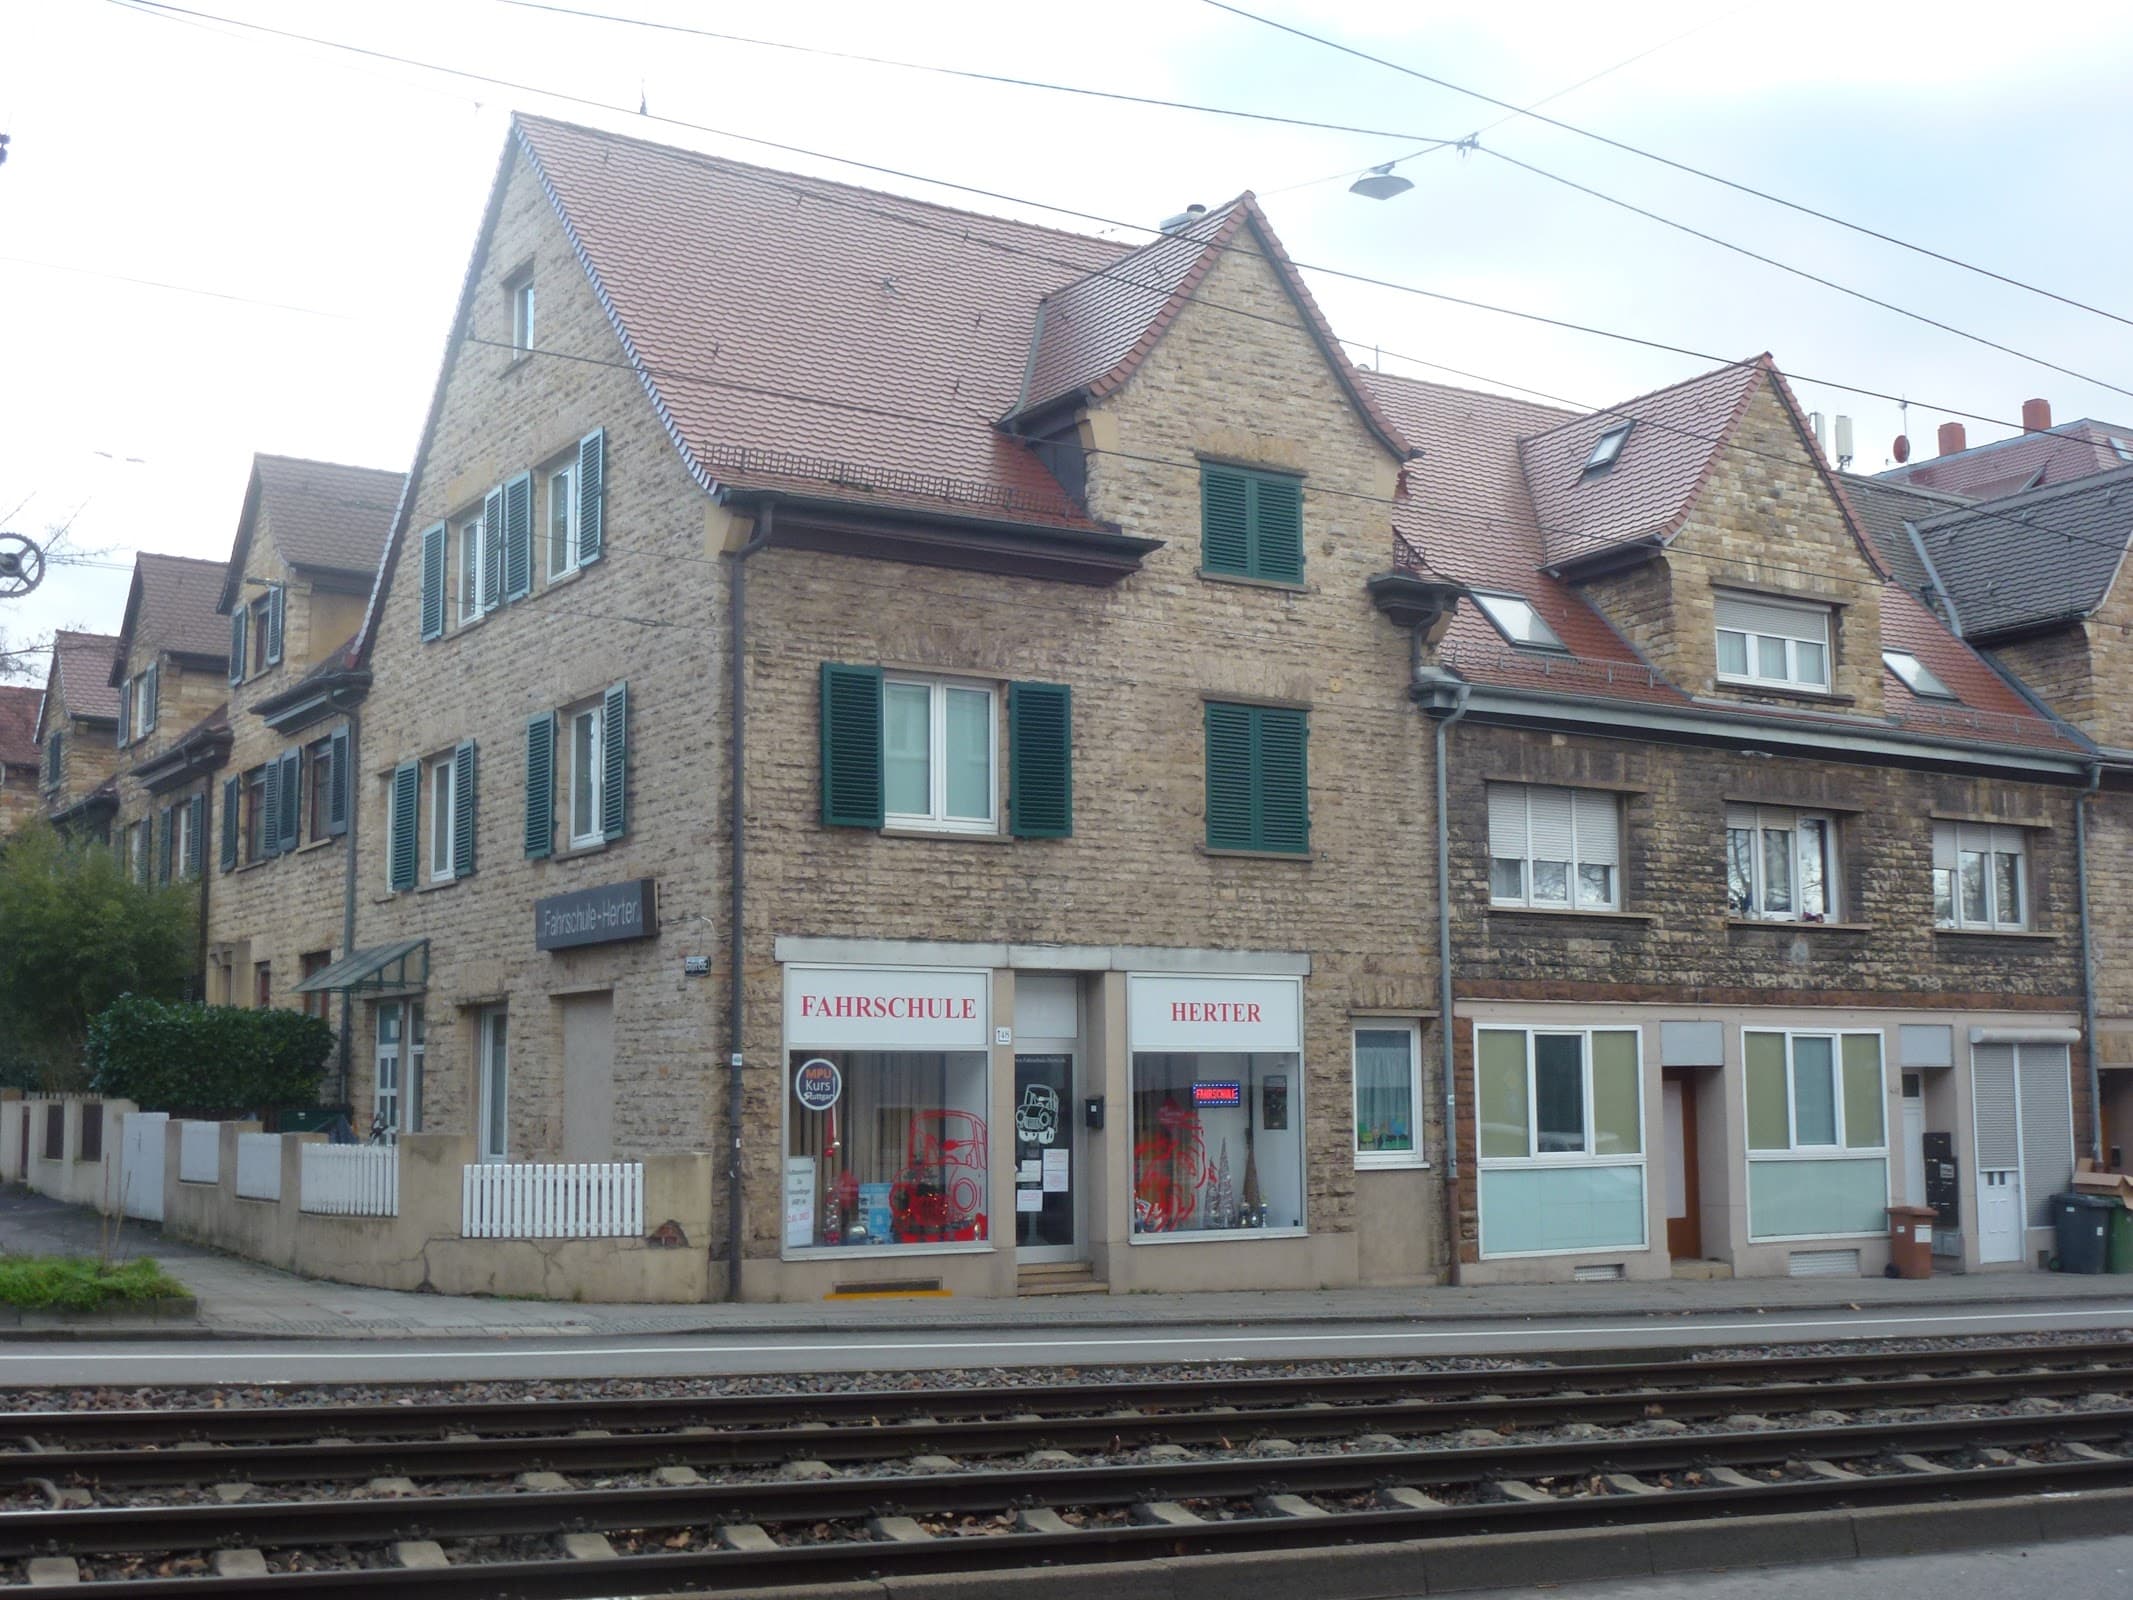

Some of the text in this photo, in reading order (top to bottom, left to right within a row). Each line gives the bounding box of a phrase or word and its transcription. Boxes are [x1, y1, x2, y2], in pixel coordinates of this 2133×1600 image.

[801, 995, 977, 1019] FAHRSCHULE
[1171, 1002, 1261, 1022] HERTER
[805, 1068, 832, 1079] MPU
[806, 1080, 831, 1092] Kurs
